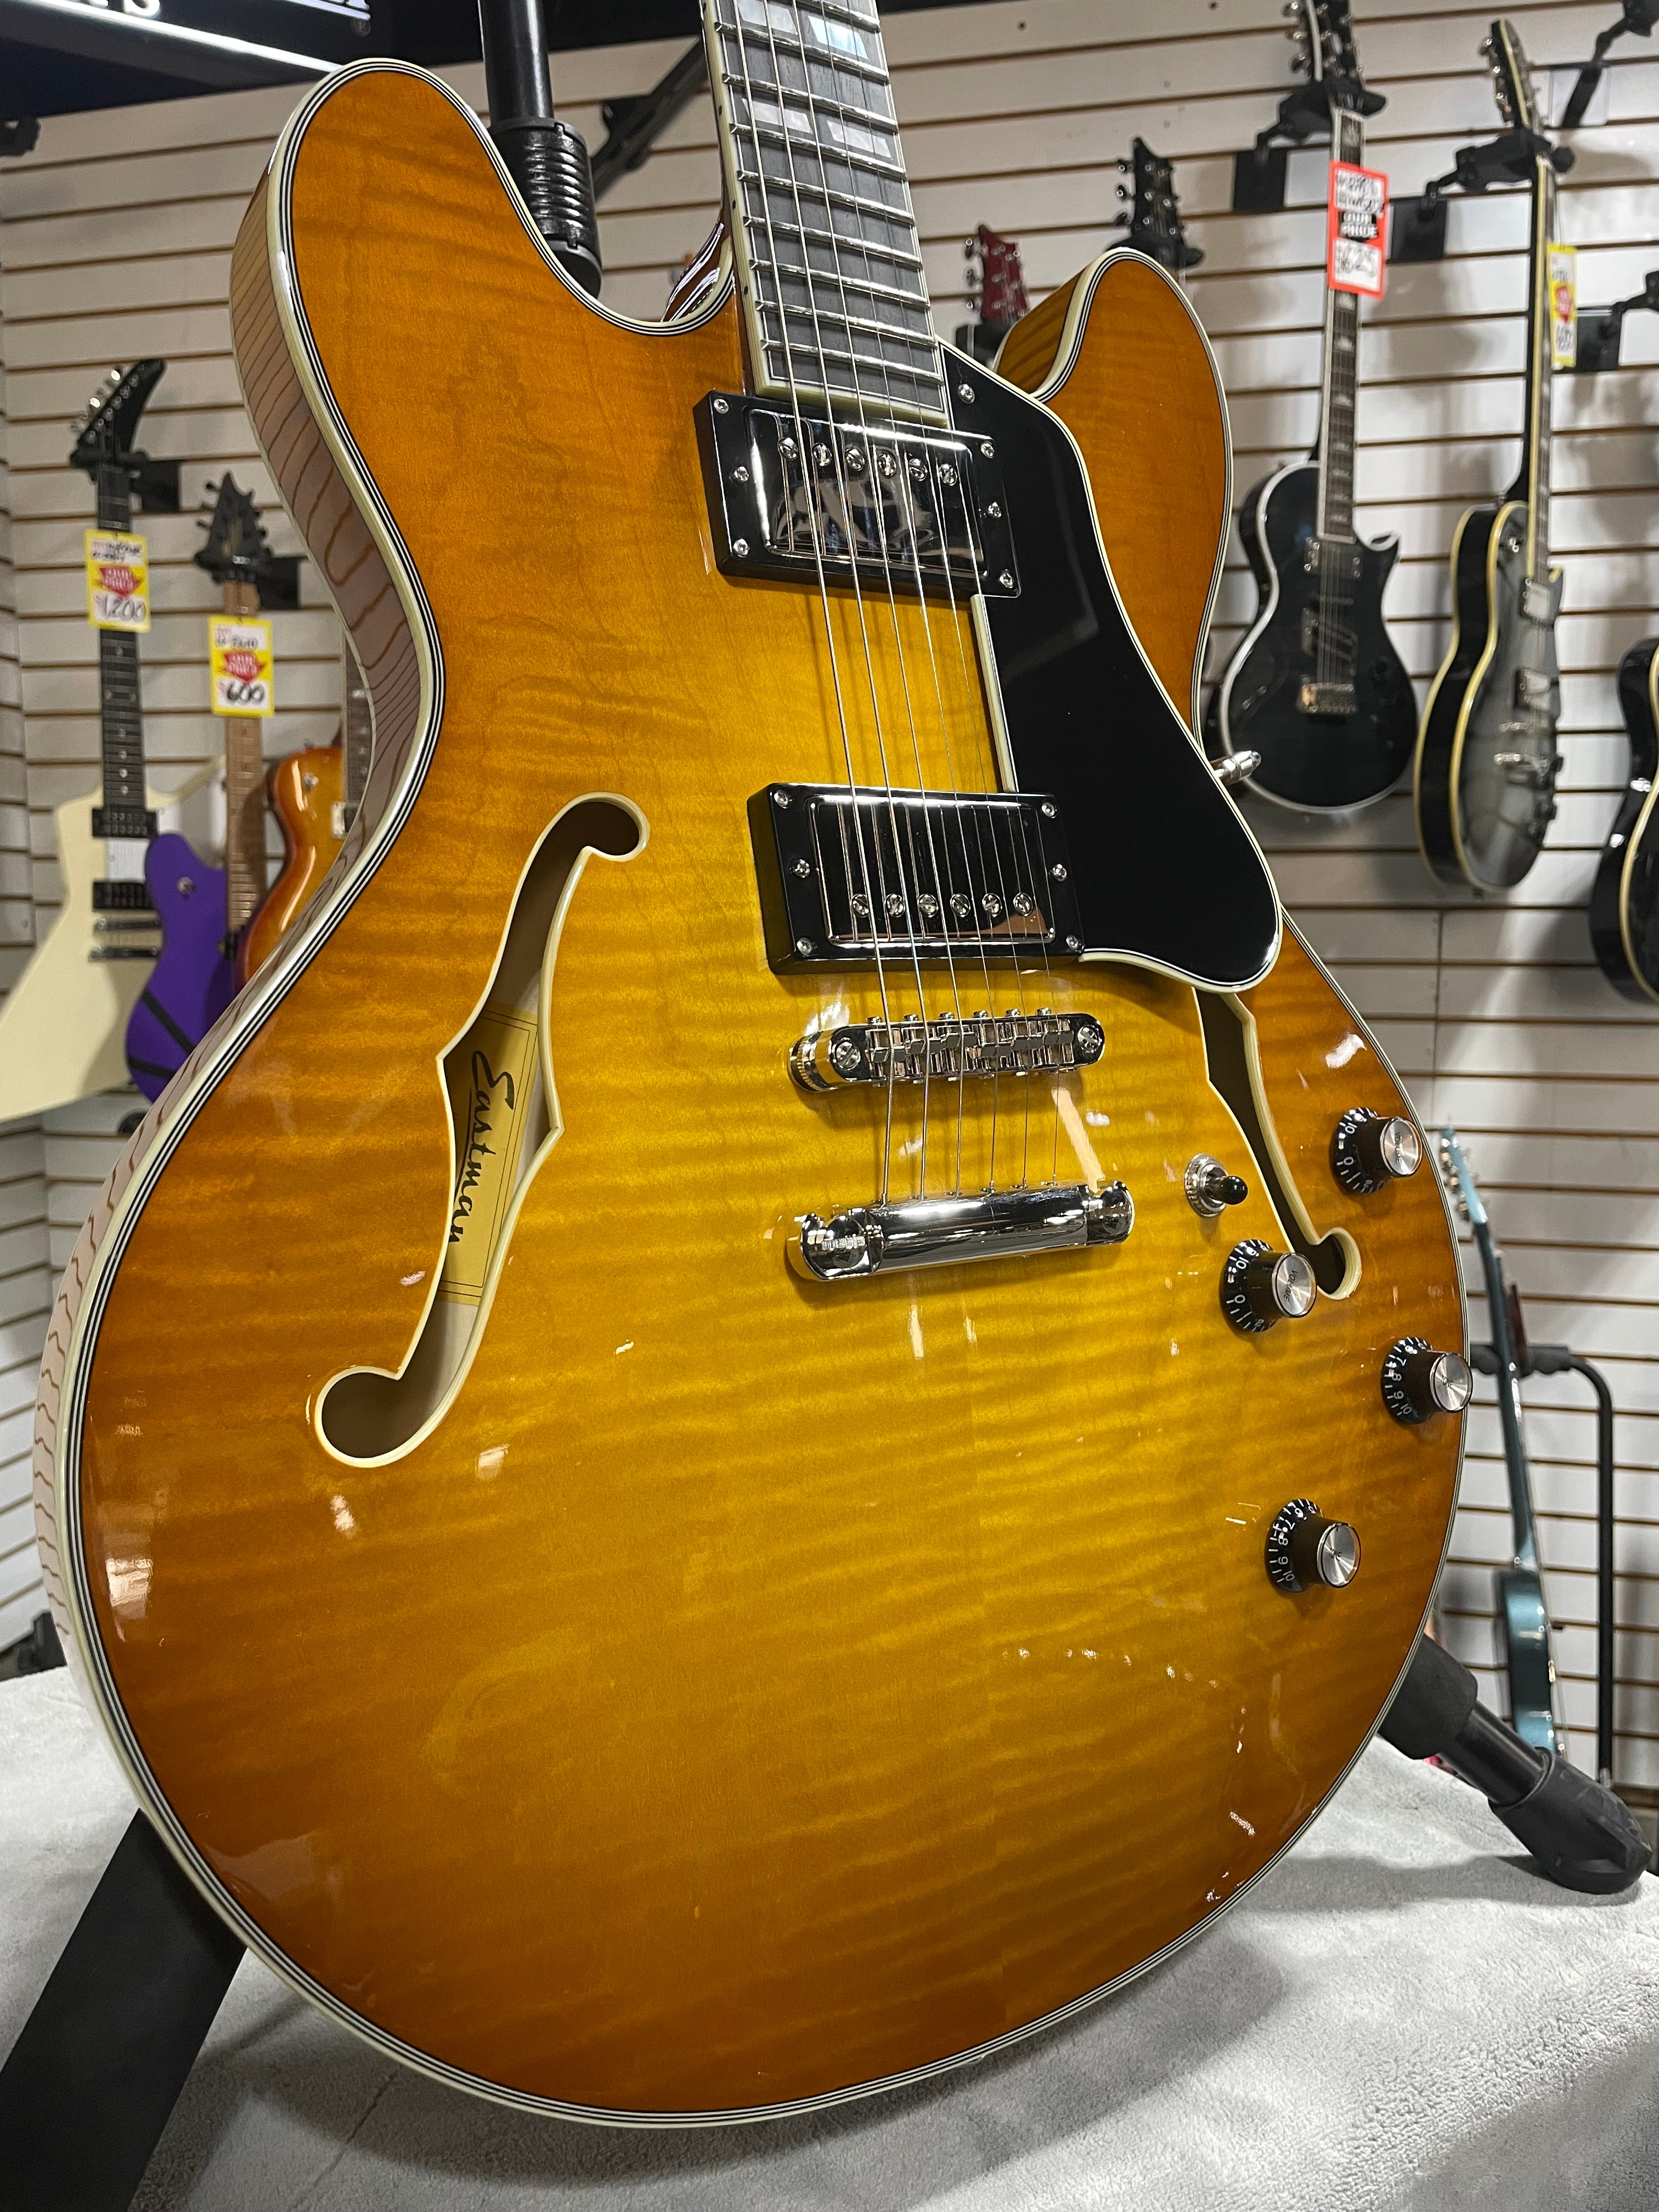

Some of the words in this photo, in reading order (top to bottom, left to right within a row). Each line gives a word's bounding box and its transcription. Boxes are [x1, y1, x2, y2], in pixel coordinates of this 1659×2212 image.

[227, 681, 265, 705] 600
[1345, 1122, 1357, 1134] 10
[448, 1050, 515, 1243] Eastman
[1344, 1156, 1354, 1165] 0
[1235, 1256, 1249, 1269] 10
[1283, 1269, 1298, 1302] VOLUME
[1234, 1294, 1246, 1304] 0
[1396, 1357, 1407, 1366] 7
[1391, 1372, 1402, 1382] 8
[1401, 1403, 1412, 1415] 10
[1285, 1519, 1295, 1530] 7
[1278, 1537, 1289, 1546] 8
[1278, 1556, 1289, 1565] 9
[1283, 1570, 1295, 1582] 10
